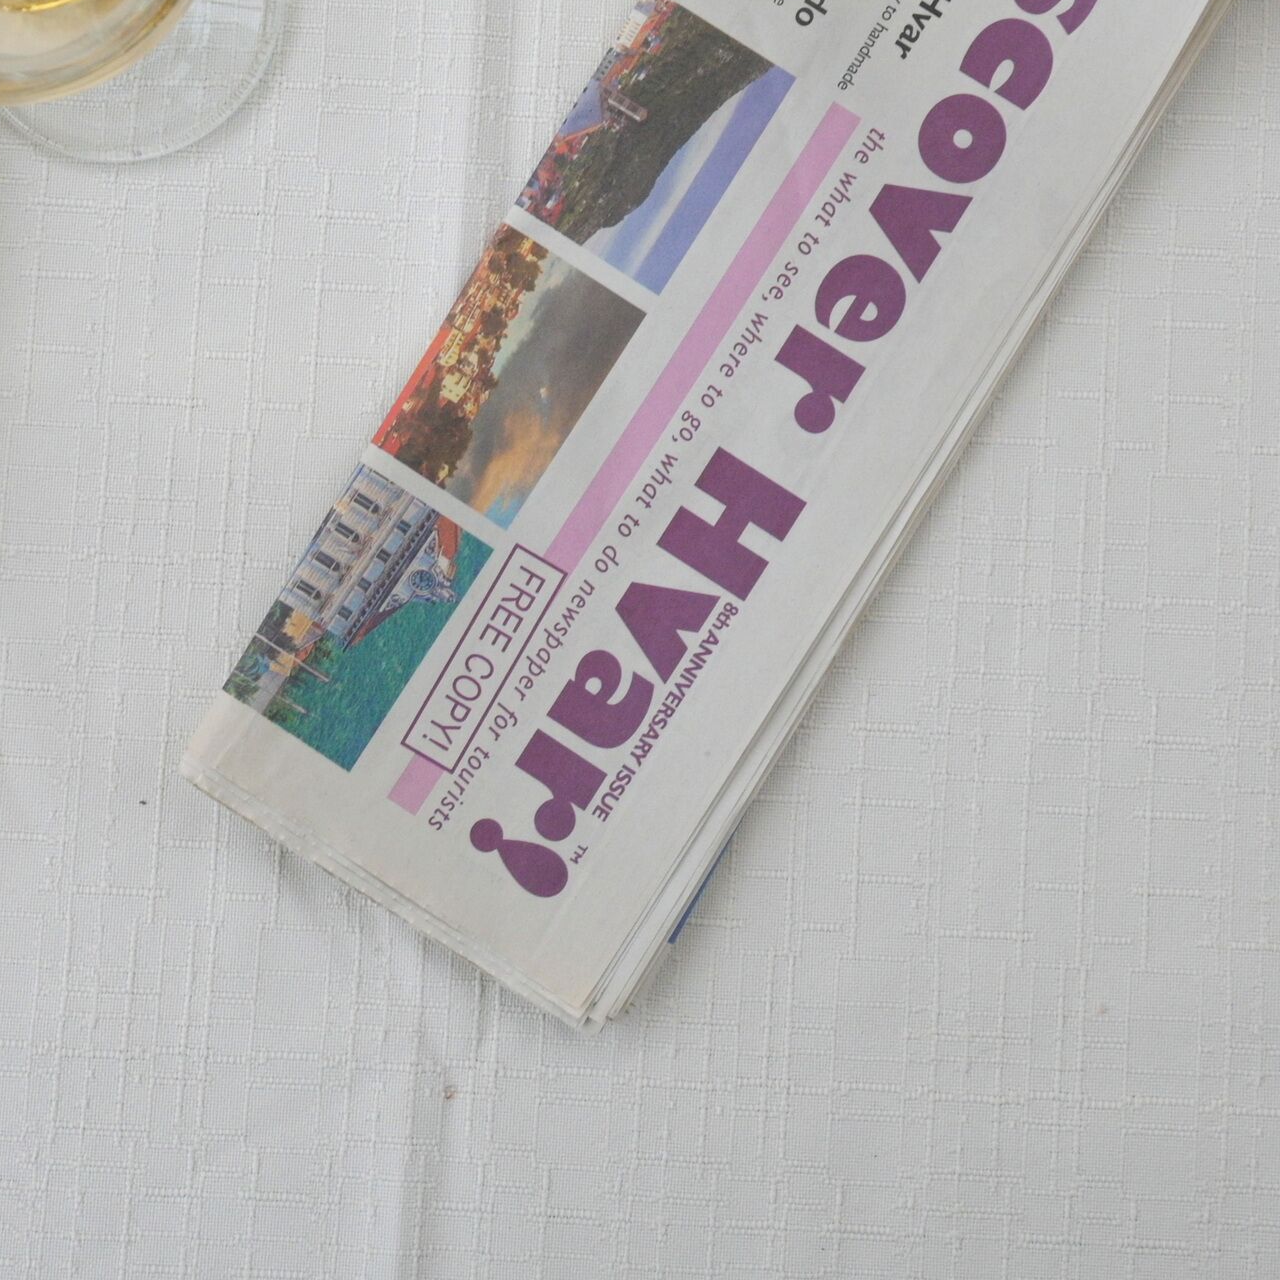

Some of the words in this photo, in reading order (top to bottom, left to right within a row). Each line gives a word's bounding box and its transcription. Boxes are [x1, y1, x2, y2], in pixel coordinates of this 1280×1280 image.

[881, 5, 897, 21] to
[837, 22, 889, 91] handmade
[854, 127, 886, 164] the
[814, 172, 858, 227] what
[797, 232, 820, 256] to
[761, 261, 799, 302] see,
[719, 312, 769, 378] where
[700, 384, 724, 408] to
[671, 410, 702, 443] go,
[635, 453, 679, 509] what
[617, 513, 640, 538] to
[594, 545, 620, 574] do
[478, 565, 546, 653] FREE
[711, 602, 739, 631] 8th
[514, 579, 596, 702] newspaper
[469, 446, 808, 899] Hvar!
[629, 628, 720, 768] ANNIVERSARY
[422, 653, 495, 752] COPY!
[488, 701, 518, 742] for
[427, 746, 491, 831] tourists
[591, 763, 636, 823] ISSUE
